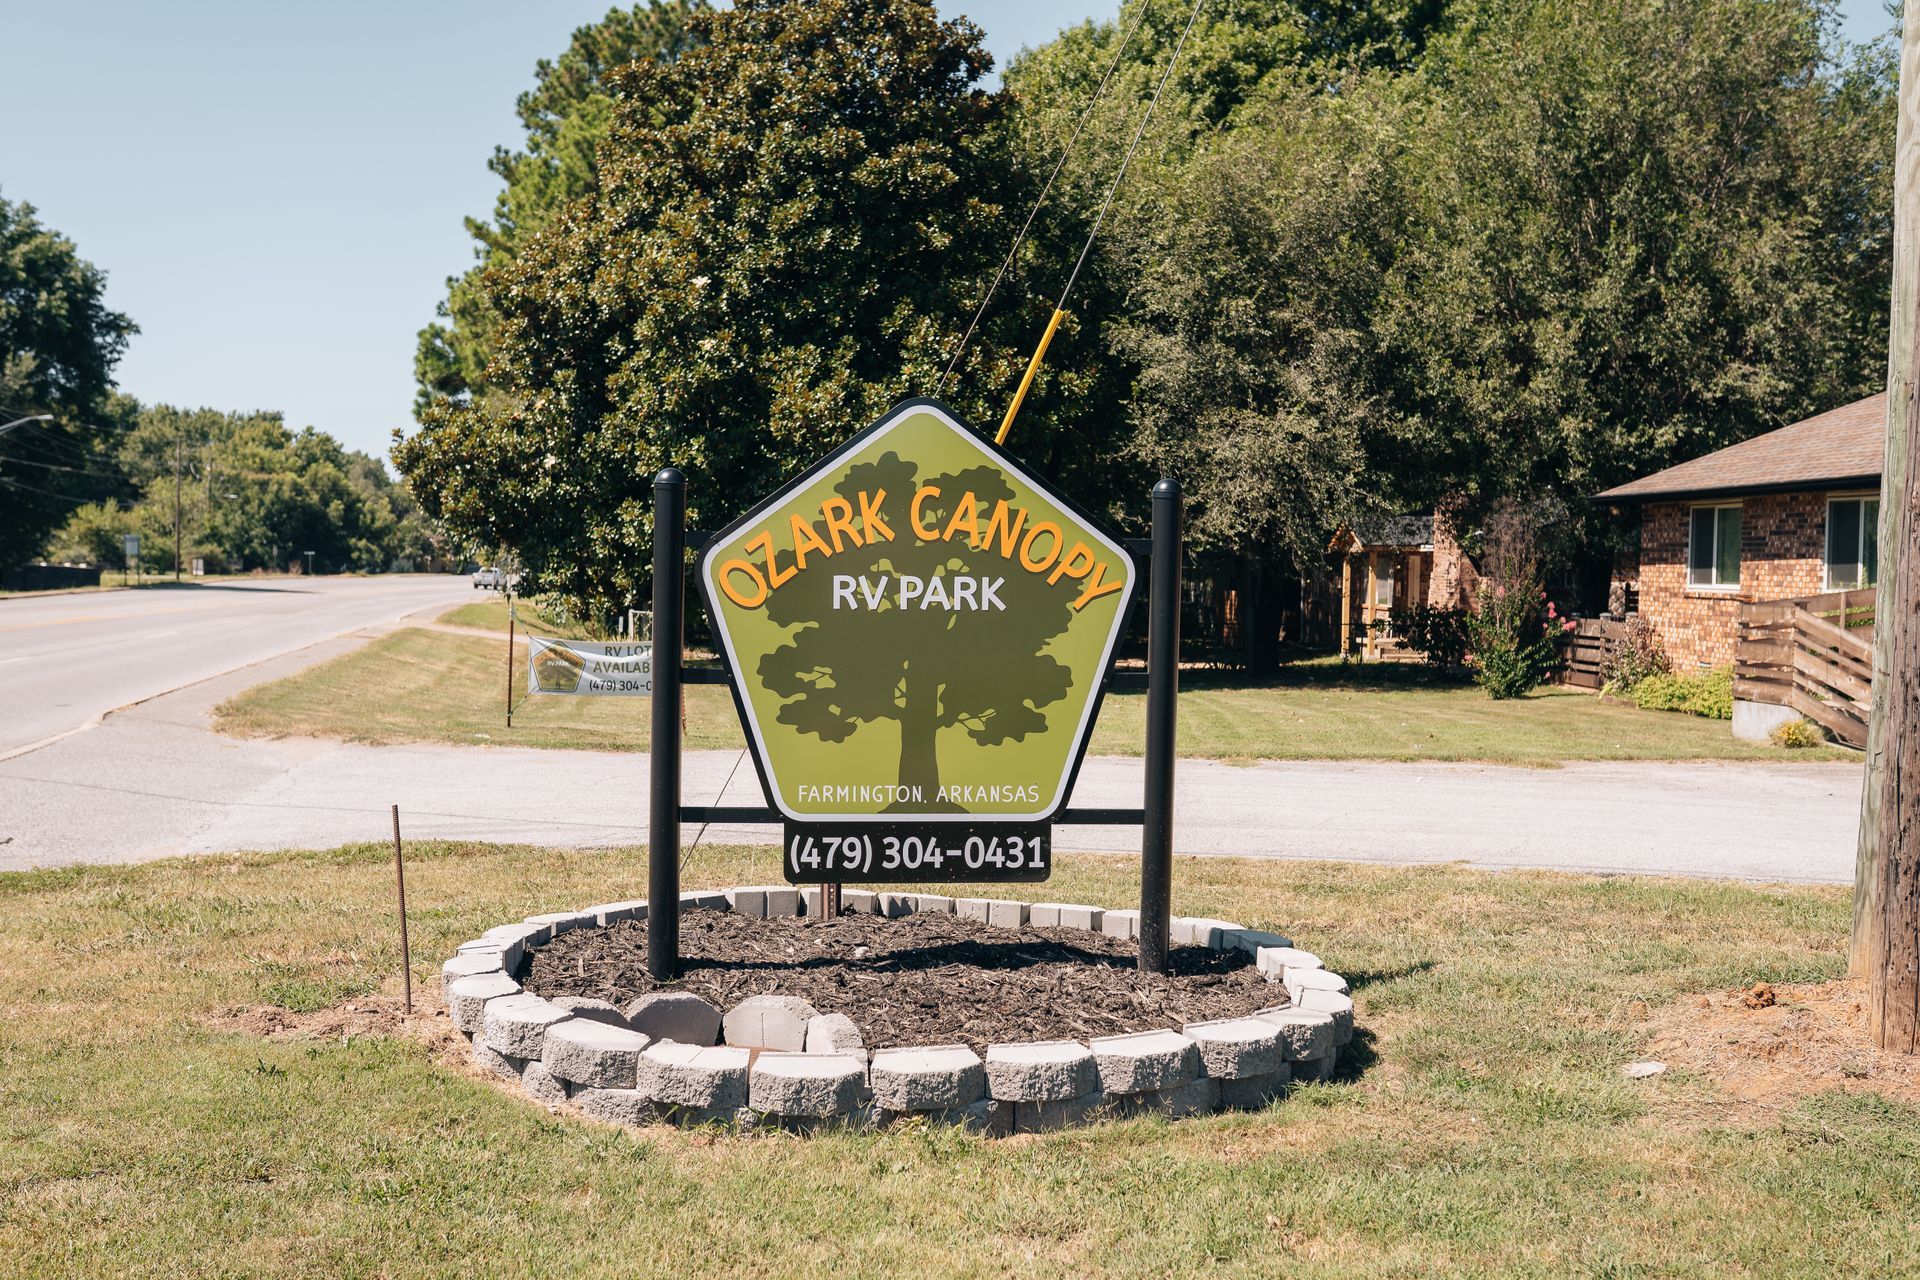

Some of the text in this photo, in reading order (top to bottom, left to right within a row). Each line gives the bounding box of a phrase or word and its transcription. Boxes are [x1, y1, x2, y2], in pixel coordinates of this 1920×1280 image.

[718, 486, 1122, 612] OZARK CANOPY
[832, 574, 1007, 612] RV PARK
[605, 646, 622, 657] RV
[593, 661, 651, 673] AVAILAB
[589, 679, 652, 692] (479) 304-0
[935, 785, 1039, 804] ARKANSAS
[790, 834, 1045, 874] (479) 304-0431
